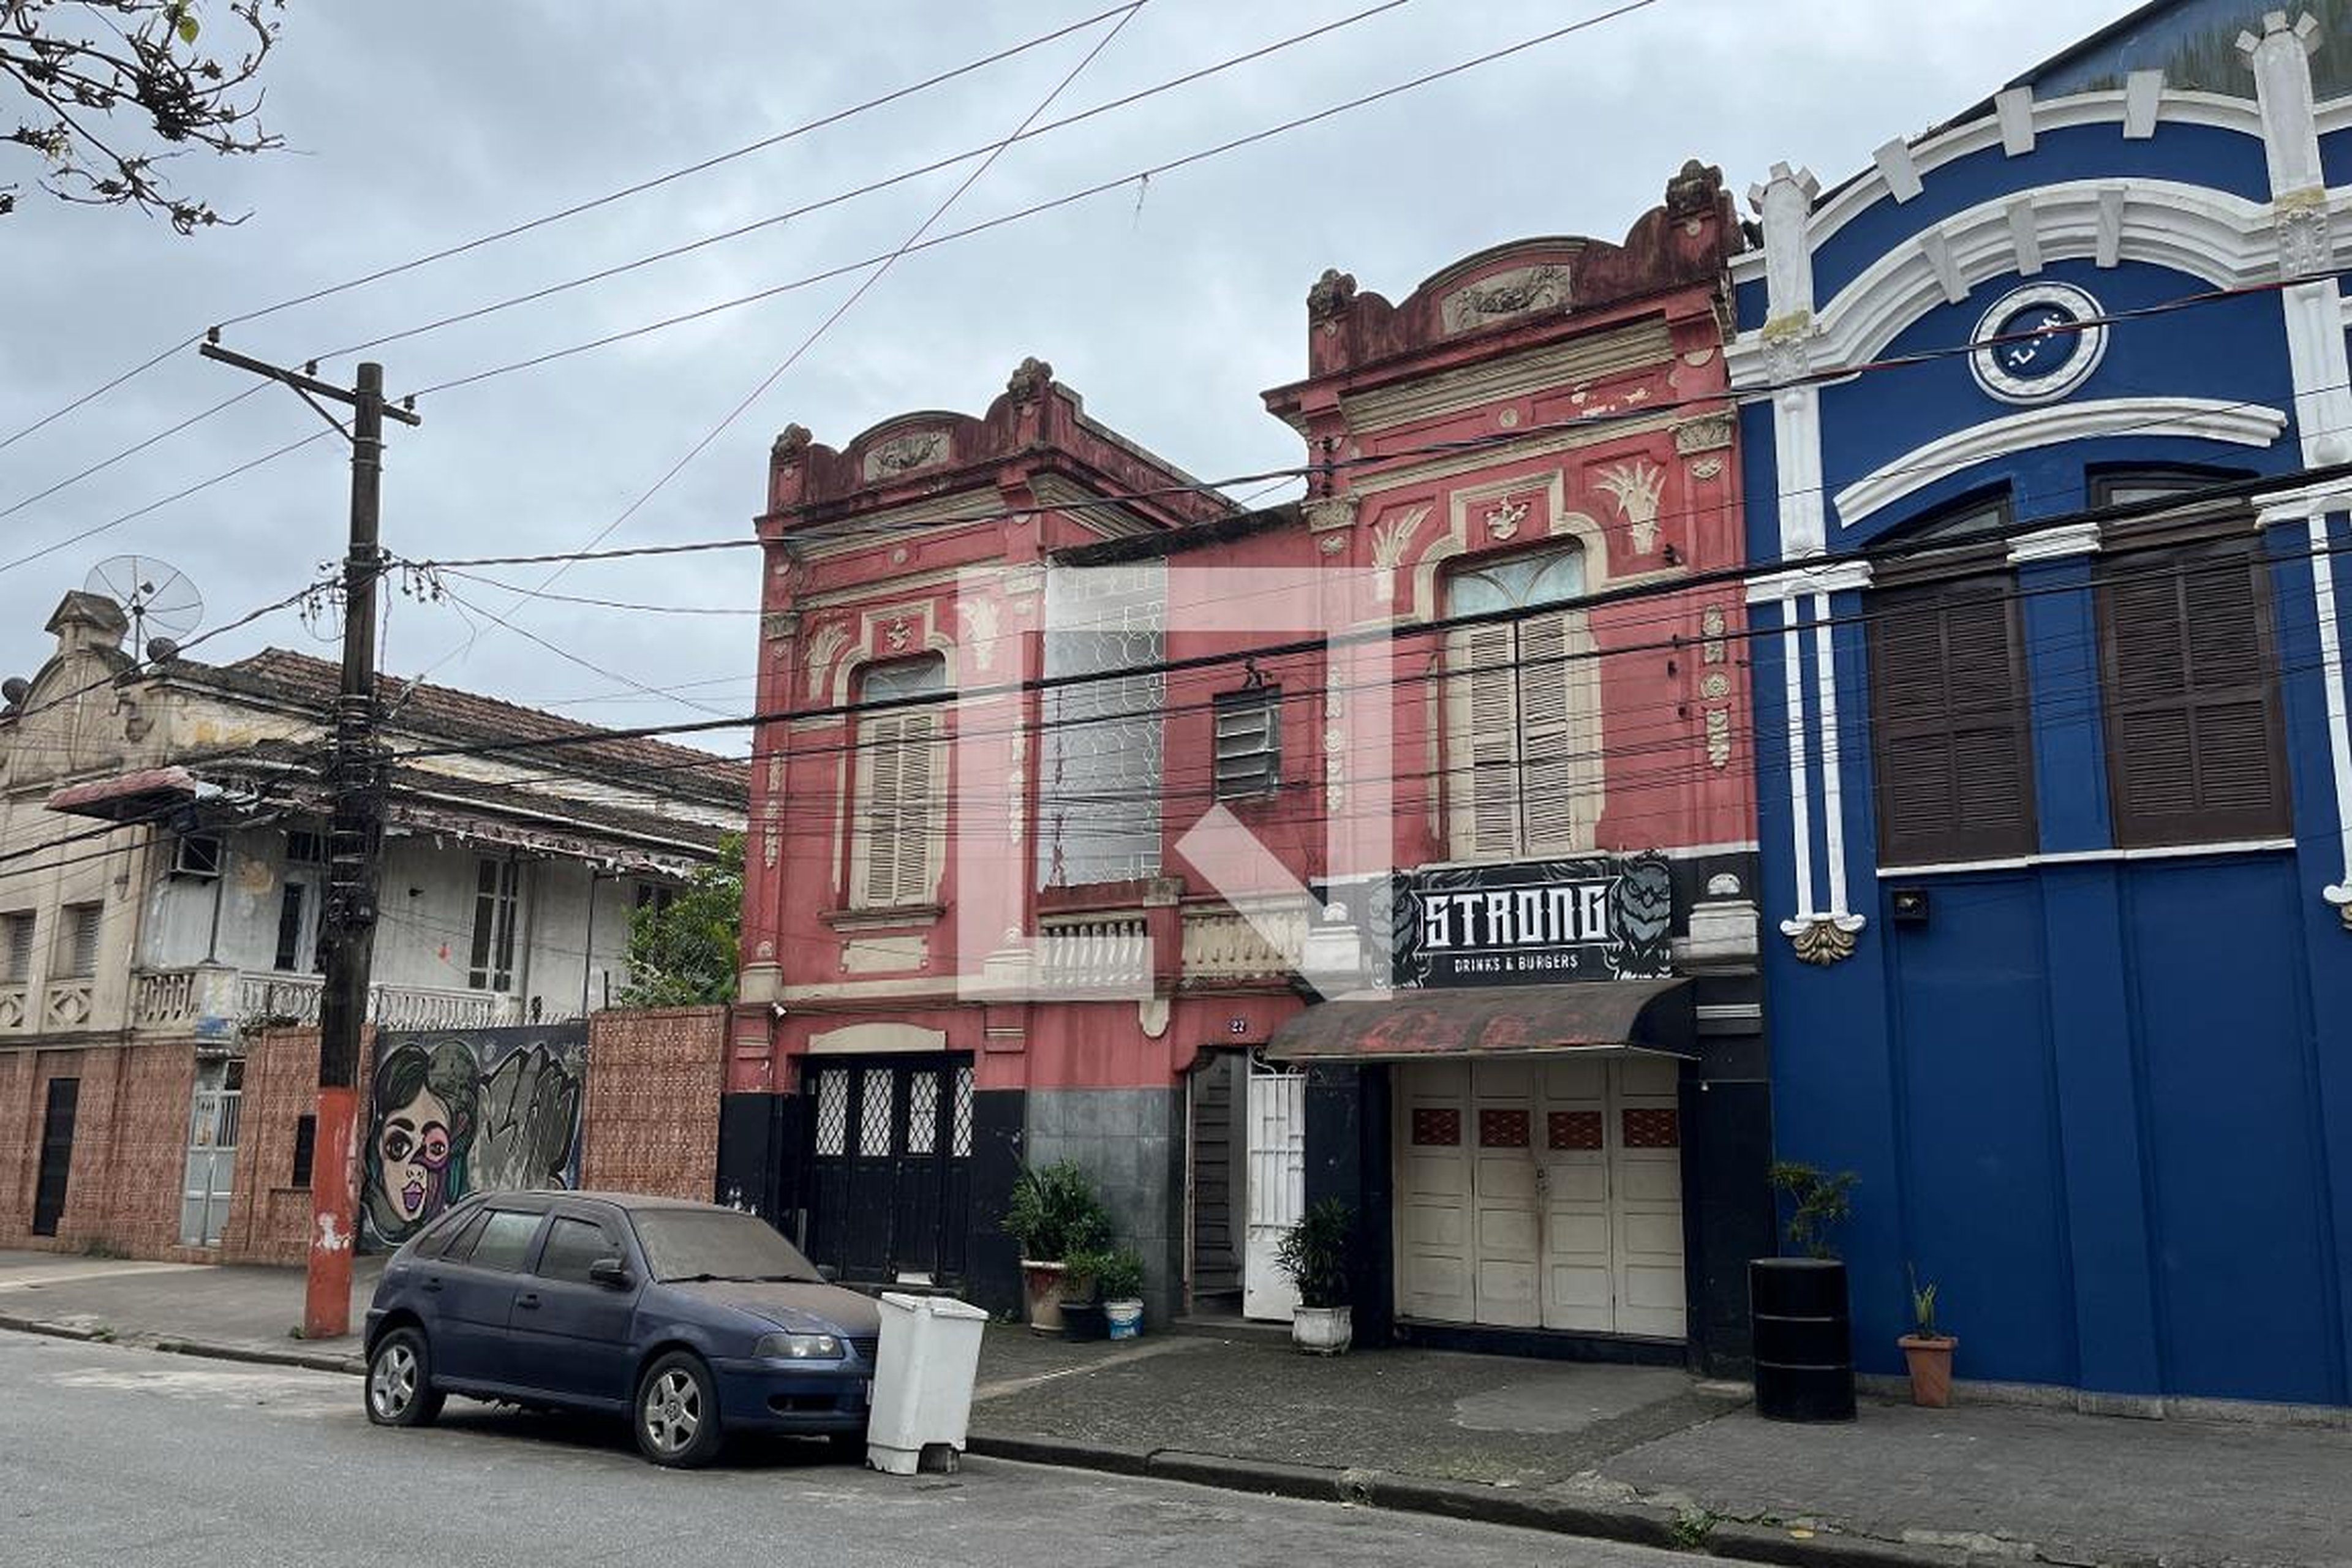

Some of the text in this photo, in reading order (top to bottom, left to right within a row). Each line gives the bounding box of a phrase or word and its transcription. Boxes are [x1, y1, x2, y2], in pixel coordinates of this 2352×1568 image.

[1425, 886, 1608, 948] STRONG
[1454, 954, 1578, 973] DRINKS & BURGERS
